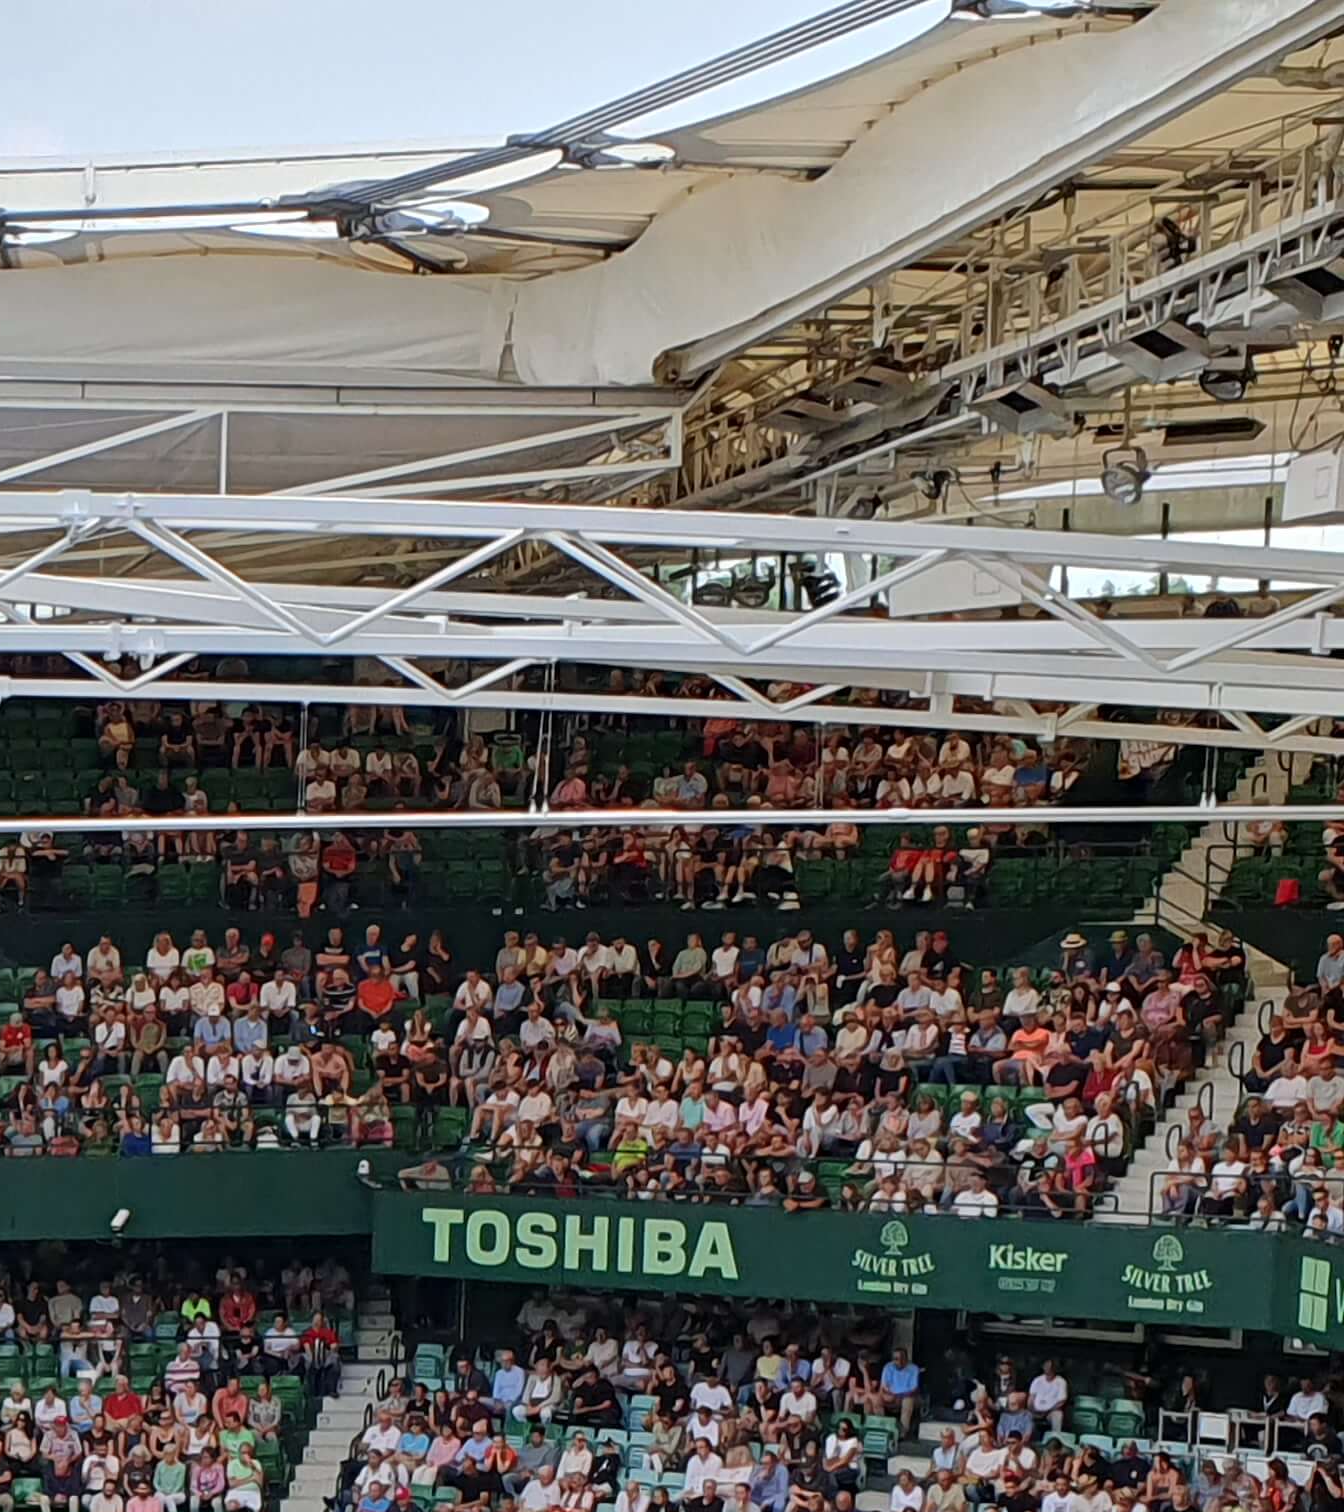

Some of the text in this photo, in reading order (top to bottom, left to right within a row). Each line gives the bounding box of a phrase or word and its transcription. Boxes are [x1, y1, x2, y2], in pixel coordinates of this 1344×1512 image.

[422, 1208, 739, 1280] TOSHIBA
[989, 1244, 1068, 1272] Kisker
[851, 1249, 936, 1277] SILVER TREE
[1121, 1265, 1212, 1293] SILVER TREE
